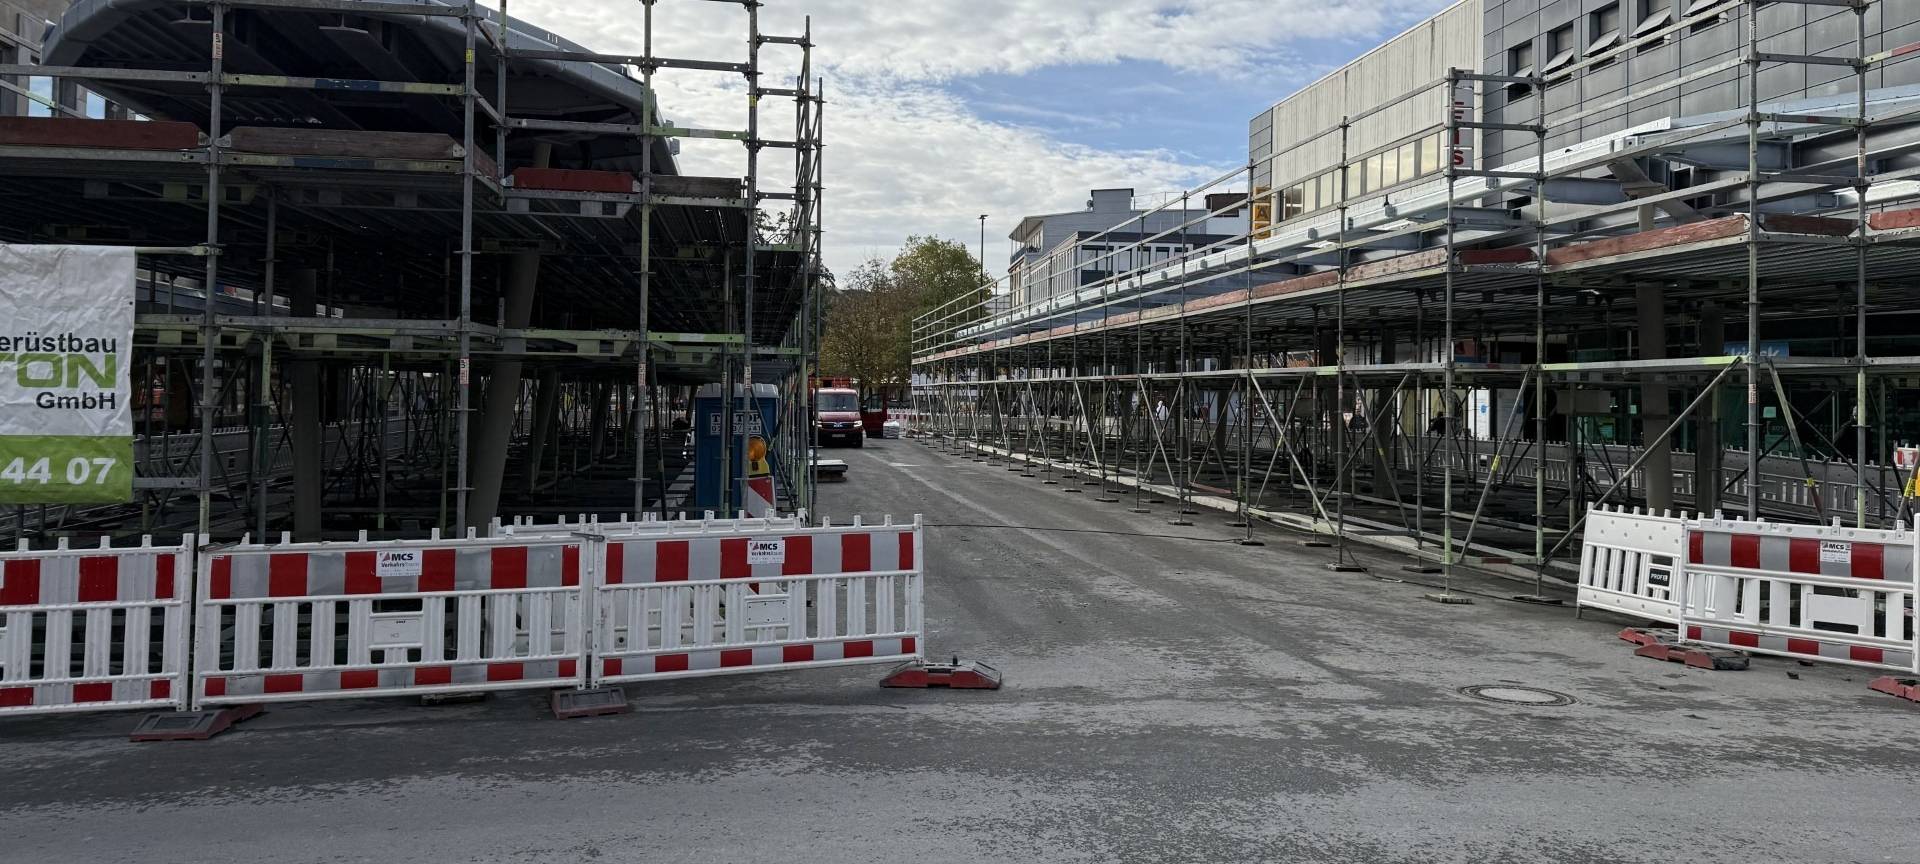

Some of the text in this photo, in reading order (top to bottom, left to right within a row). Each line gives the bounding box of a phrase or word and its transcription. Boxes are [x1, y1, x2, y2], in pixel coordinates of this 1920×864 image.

[0, 332, 116, 353] erüstbau
[36, 392, 116, 409] GmbH
[0, 457, 116, 485] 44 07
[391, 553, 413, 561] MCS
